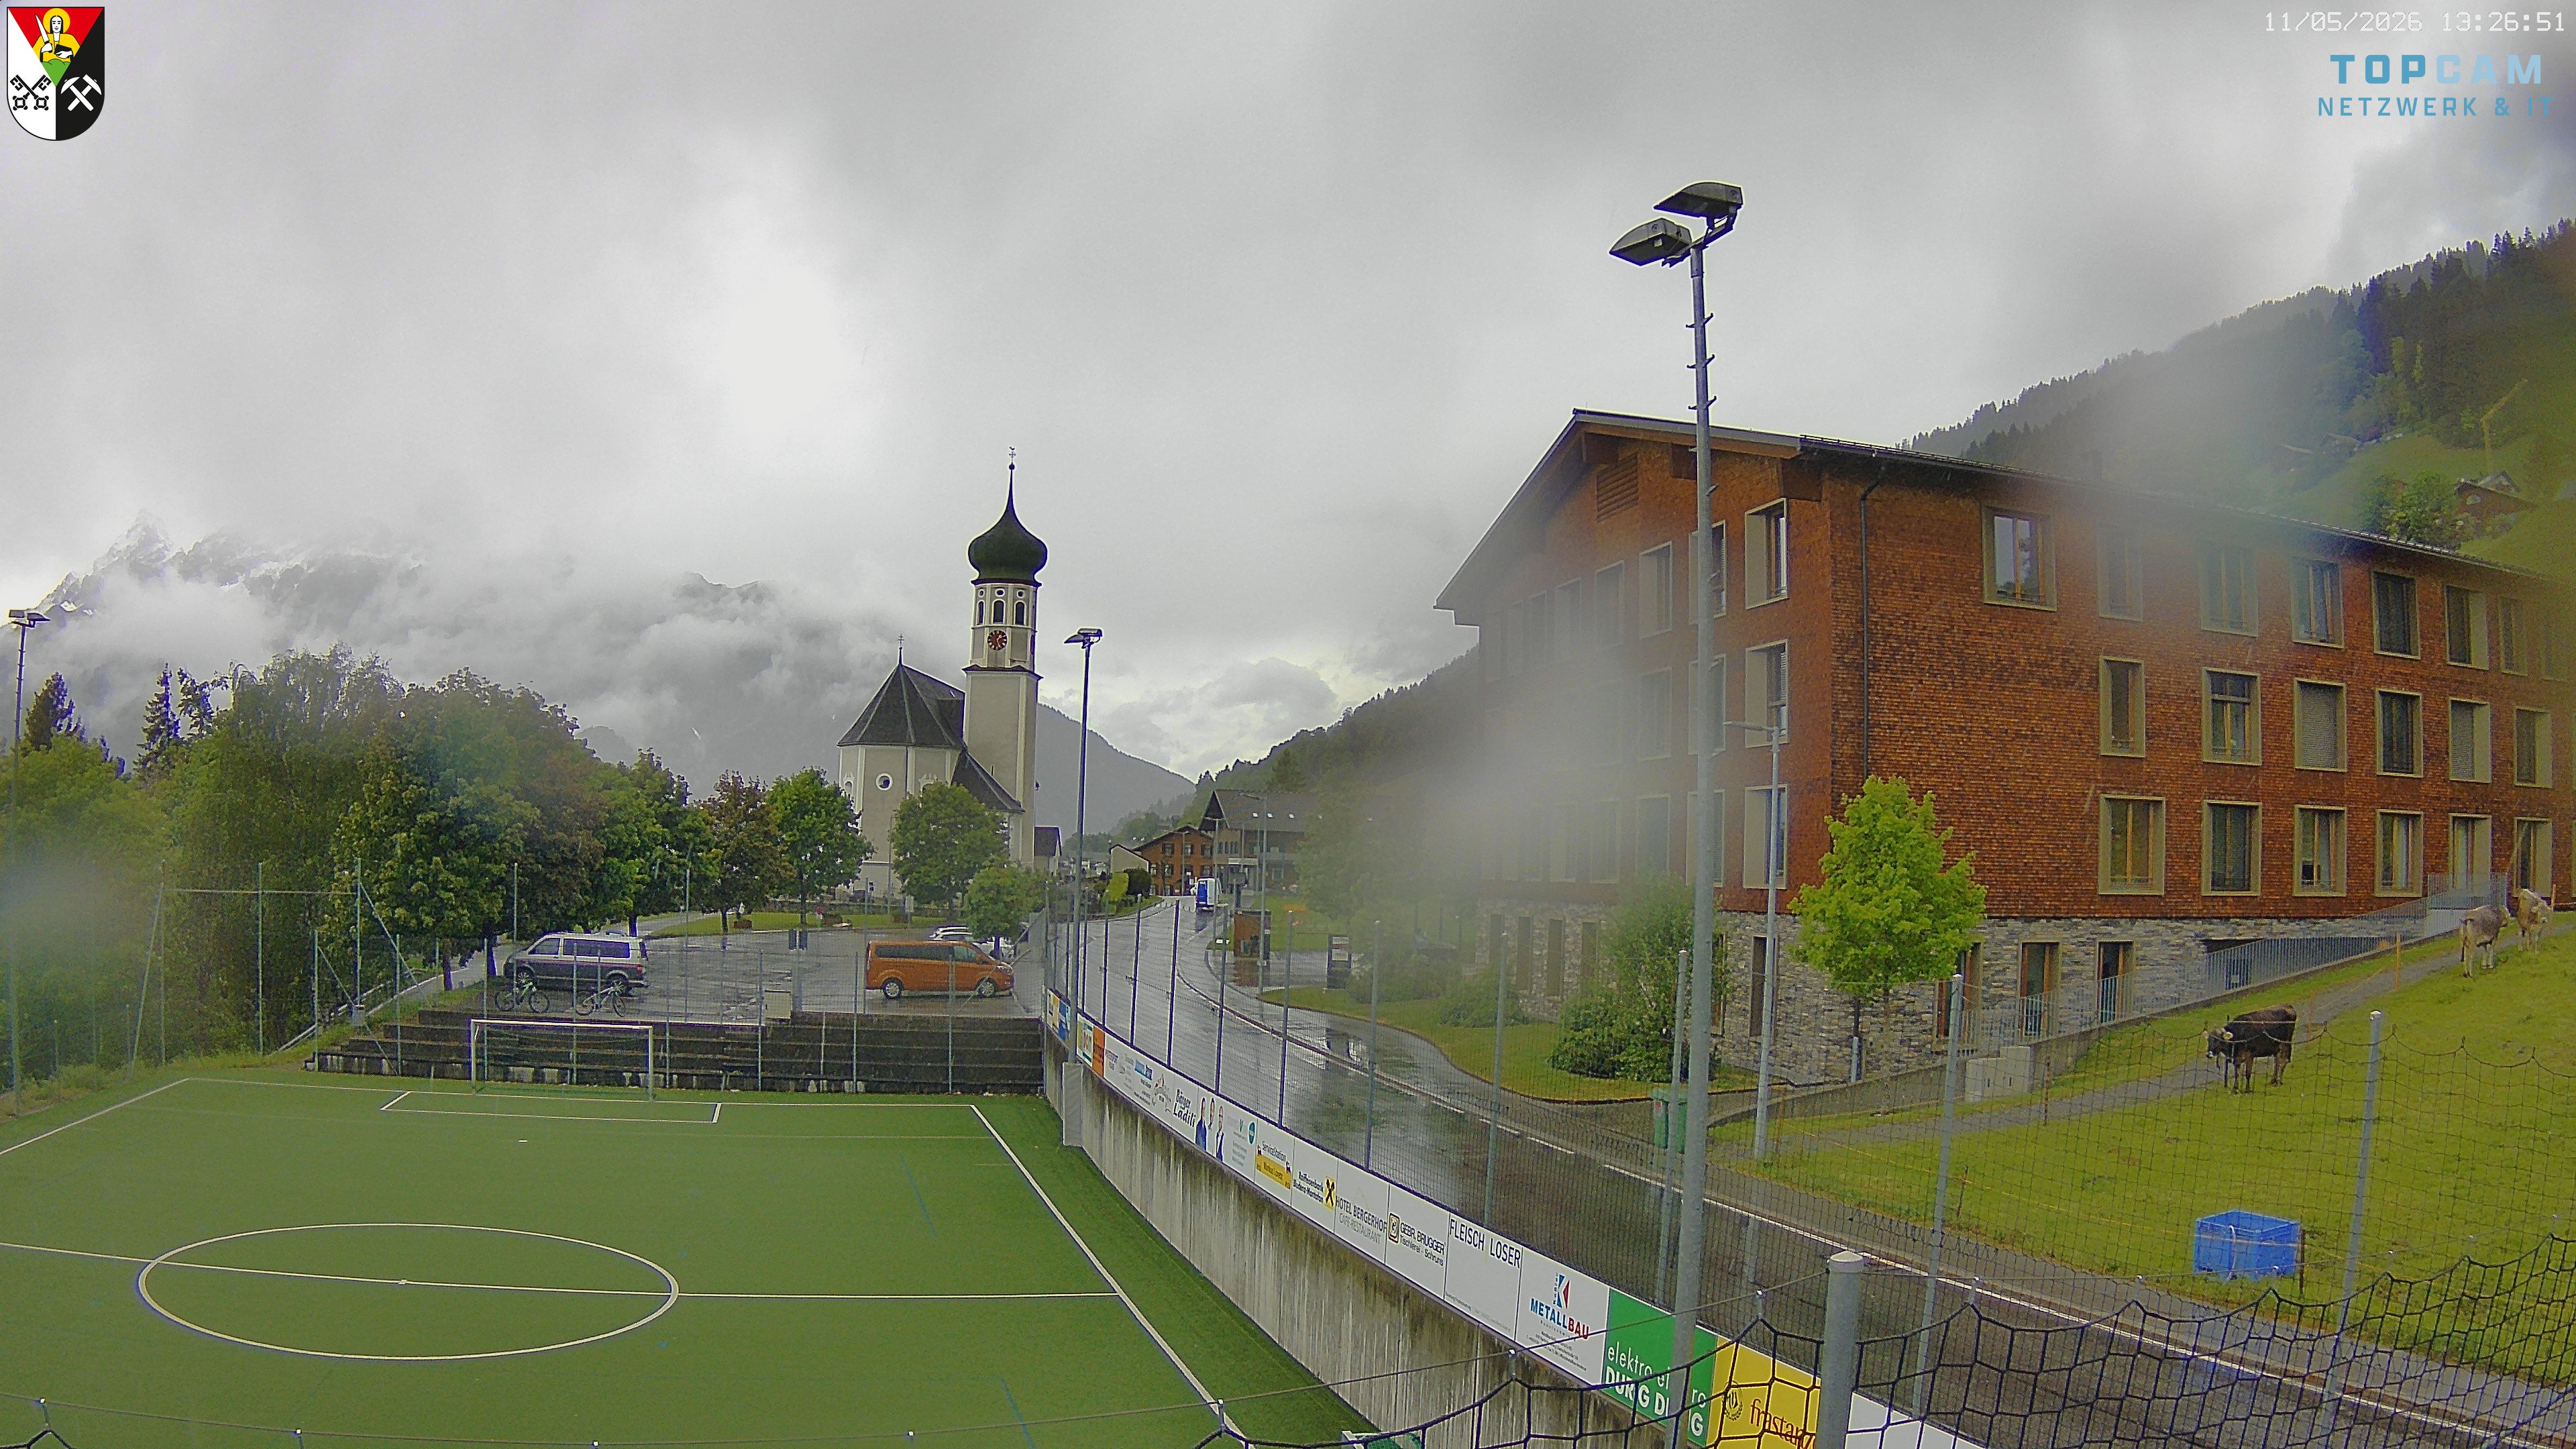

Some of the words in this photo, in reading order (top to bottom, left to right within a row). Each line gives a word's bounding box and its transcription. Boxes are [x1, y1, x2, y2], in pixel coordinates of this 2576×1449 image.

[1336, 1195, 1352, 1215] HOTEL
[1353, 1205, 1388, 1233] BERGERHOF
[1400, 1234, 1421, 1253] Tischlerei
[1424, 1248, 1444, 1267] Schruns
[1417, 1230, 1444, 1255] BRUGGER
[1450, 1218, 1485, 1252] FLEISCH
[1490, 1238, 1521, 1269] LOSER
[1530, 1297, 1590, 1340] METALLBAU
[1607, 1341, 1653, 1377] elektro
